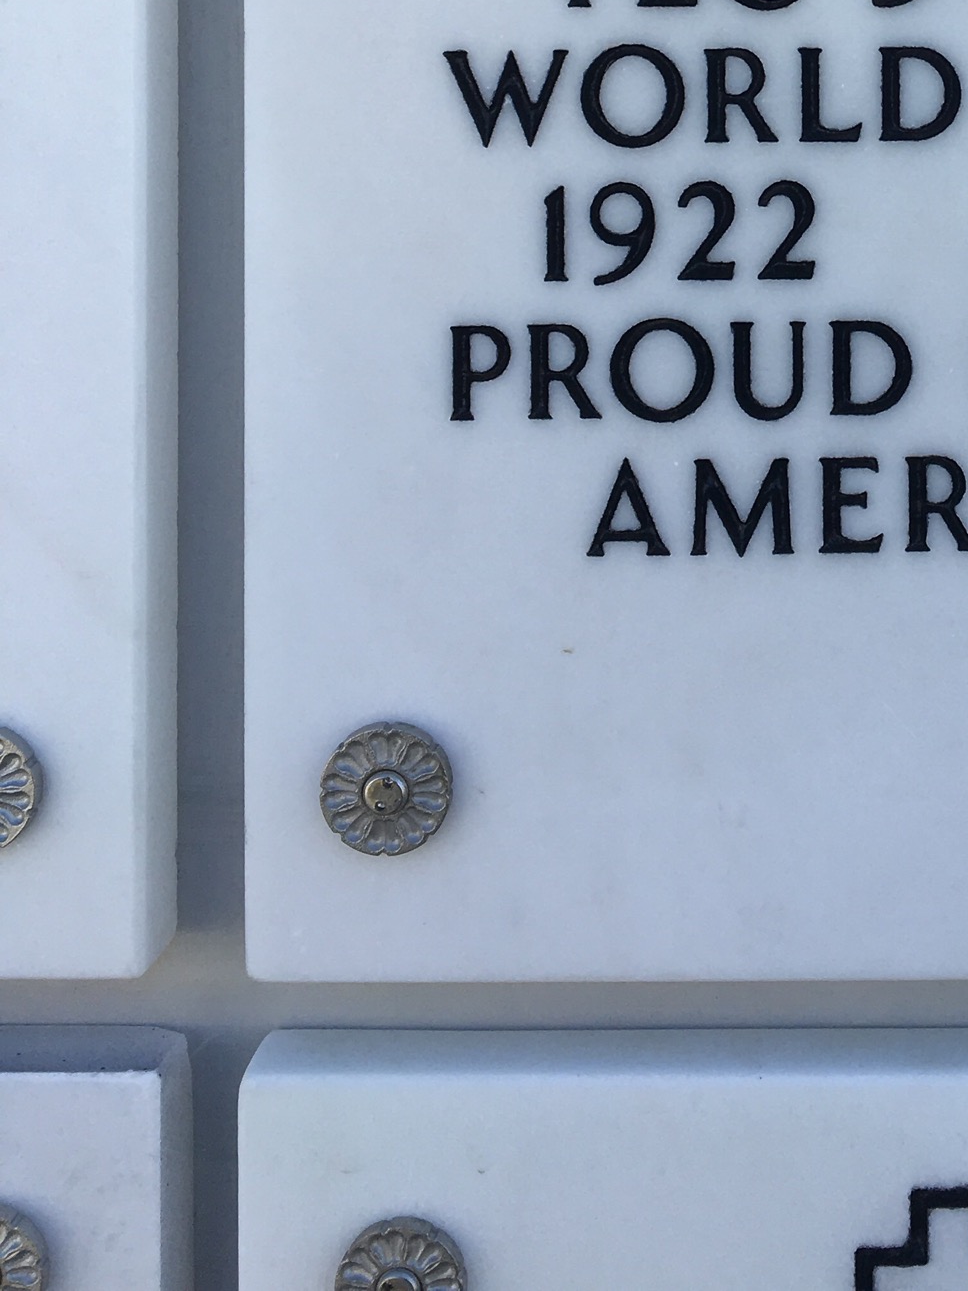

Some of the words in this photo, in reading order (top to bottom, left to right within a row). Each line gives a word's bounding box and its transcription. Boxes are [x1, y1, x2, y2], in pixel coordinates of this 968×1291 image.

[442, 43, 963, 150] WORLD
[543, 179, 817, 287] 1922
[449, 317, 914, 424] PROUD
